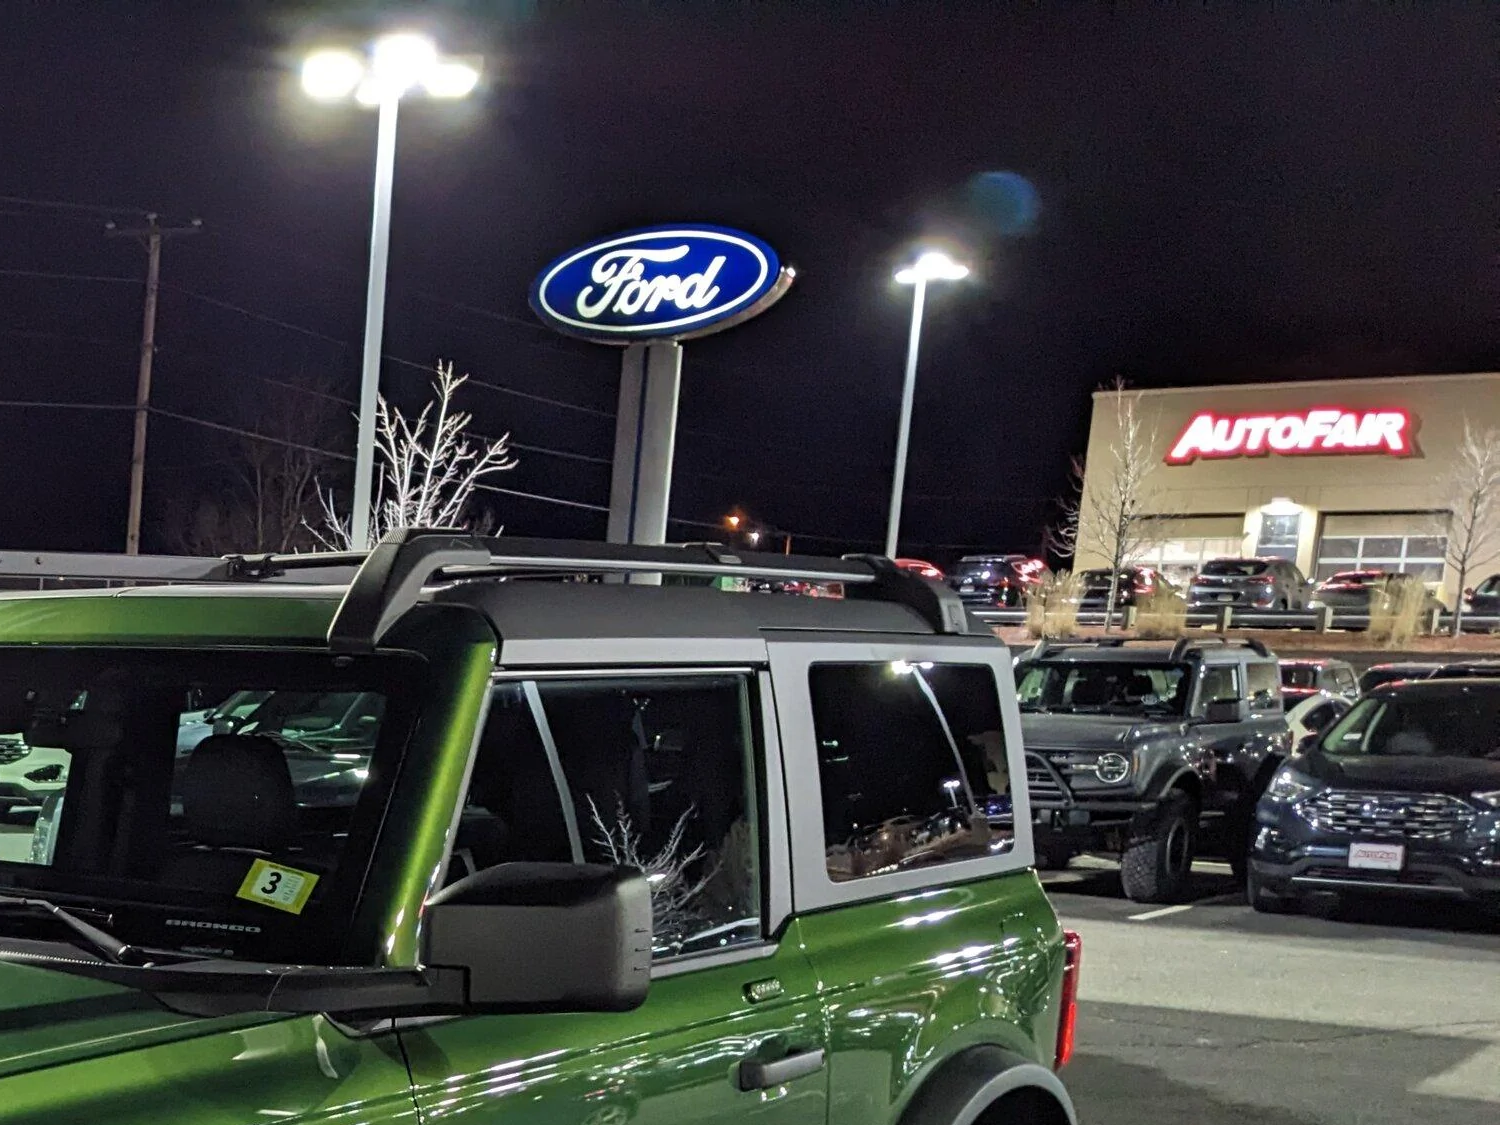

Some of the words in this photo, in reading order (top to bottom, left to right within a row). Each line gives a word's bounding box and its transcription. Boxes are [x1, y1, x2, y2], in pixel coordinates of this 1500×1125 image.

[576, 244, 727, 319] Ford
[260, 871, 282, 895] 3
[165, 919, 262, 933] BRONCO
